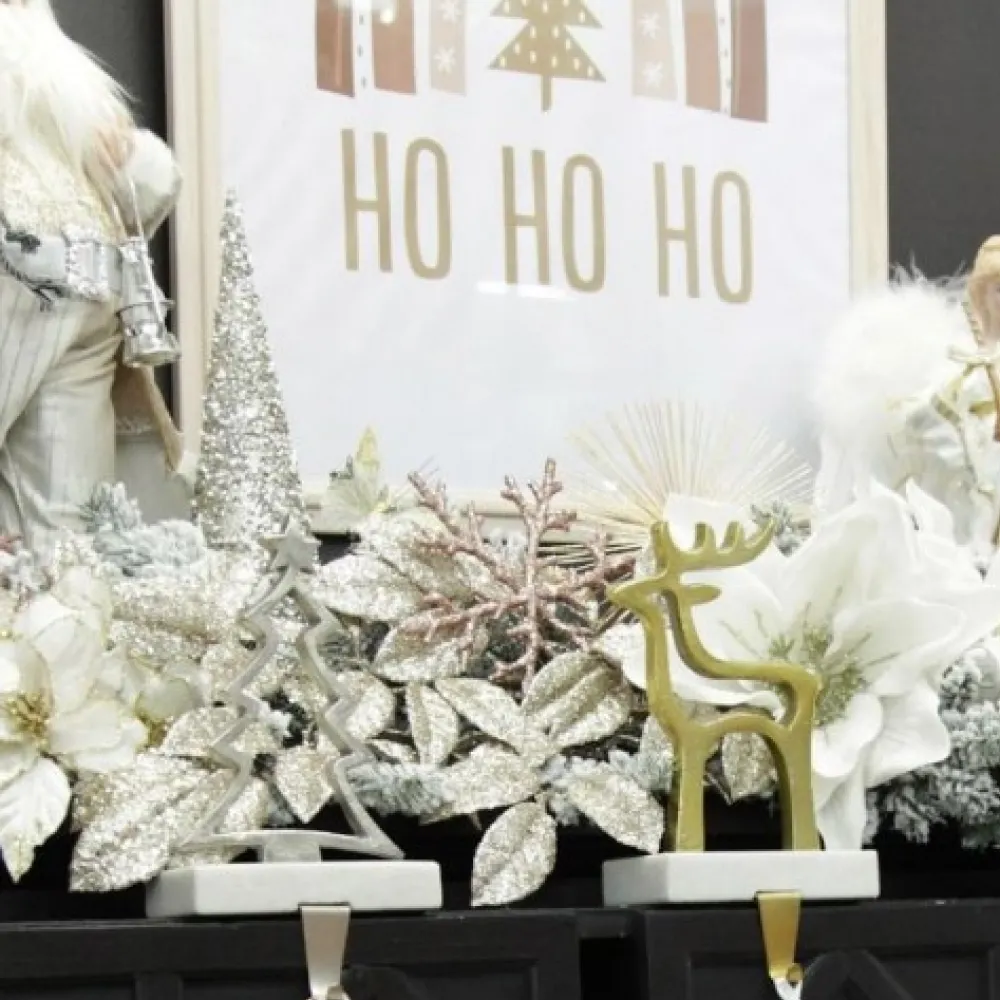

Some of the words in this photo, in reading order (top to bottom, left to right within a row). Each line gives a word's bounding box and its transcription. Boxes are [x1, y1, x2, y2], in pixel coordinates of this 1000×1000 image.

[341, 128, 452, 280] HO
[501, 145, 605, 293] HO
[653, 161, 754, 304] HO
